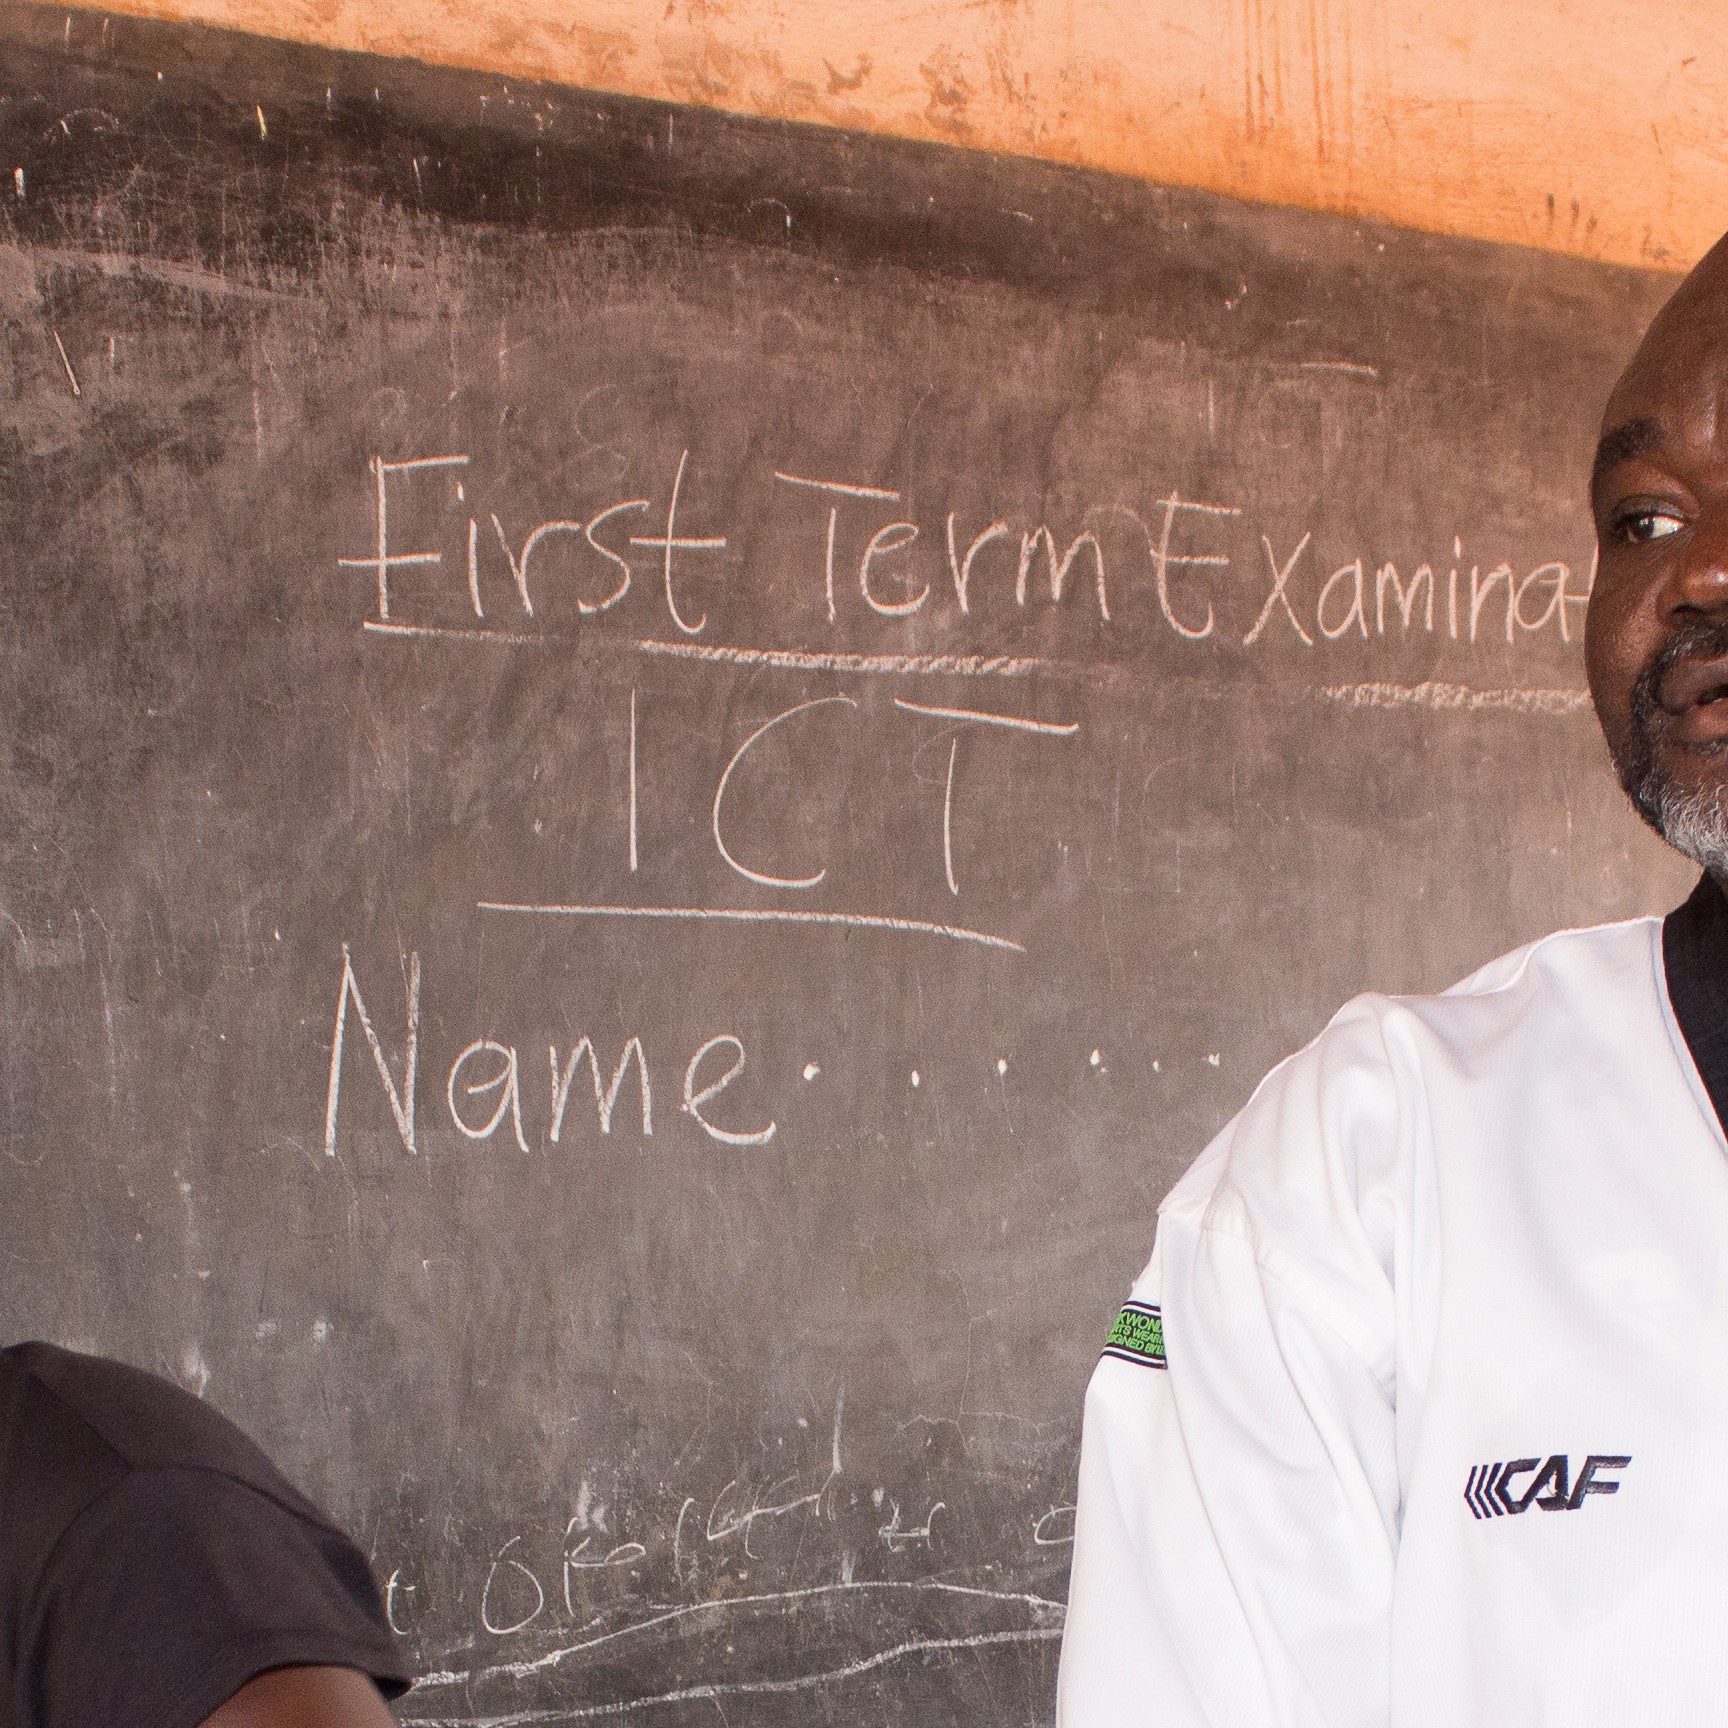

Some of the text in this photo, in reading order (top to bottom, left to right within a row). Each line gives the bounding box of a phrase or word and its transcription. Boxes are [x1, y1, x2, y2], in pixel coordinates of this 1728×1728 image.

[337, 449, 1598, 648] First Term Examina
[627, 686, 1081, 896] ICT
